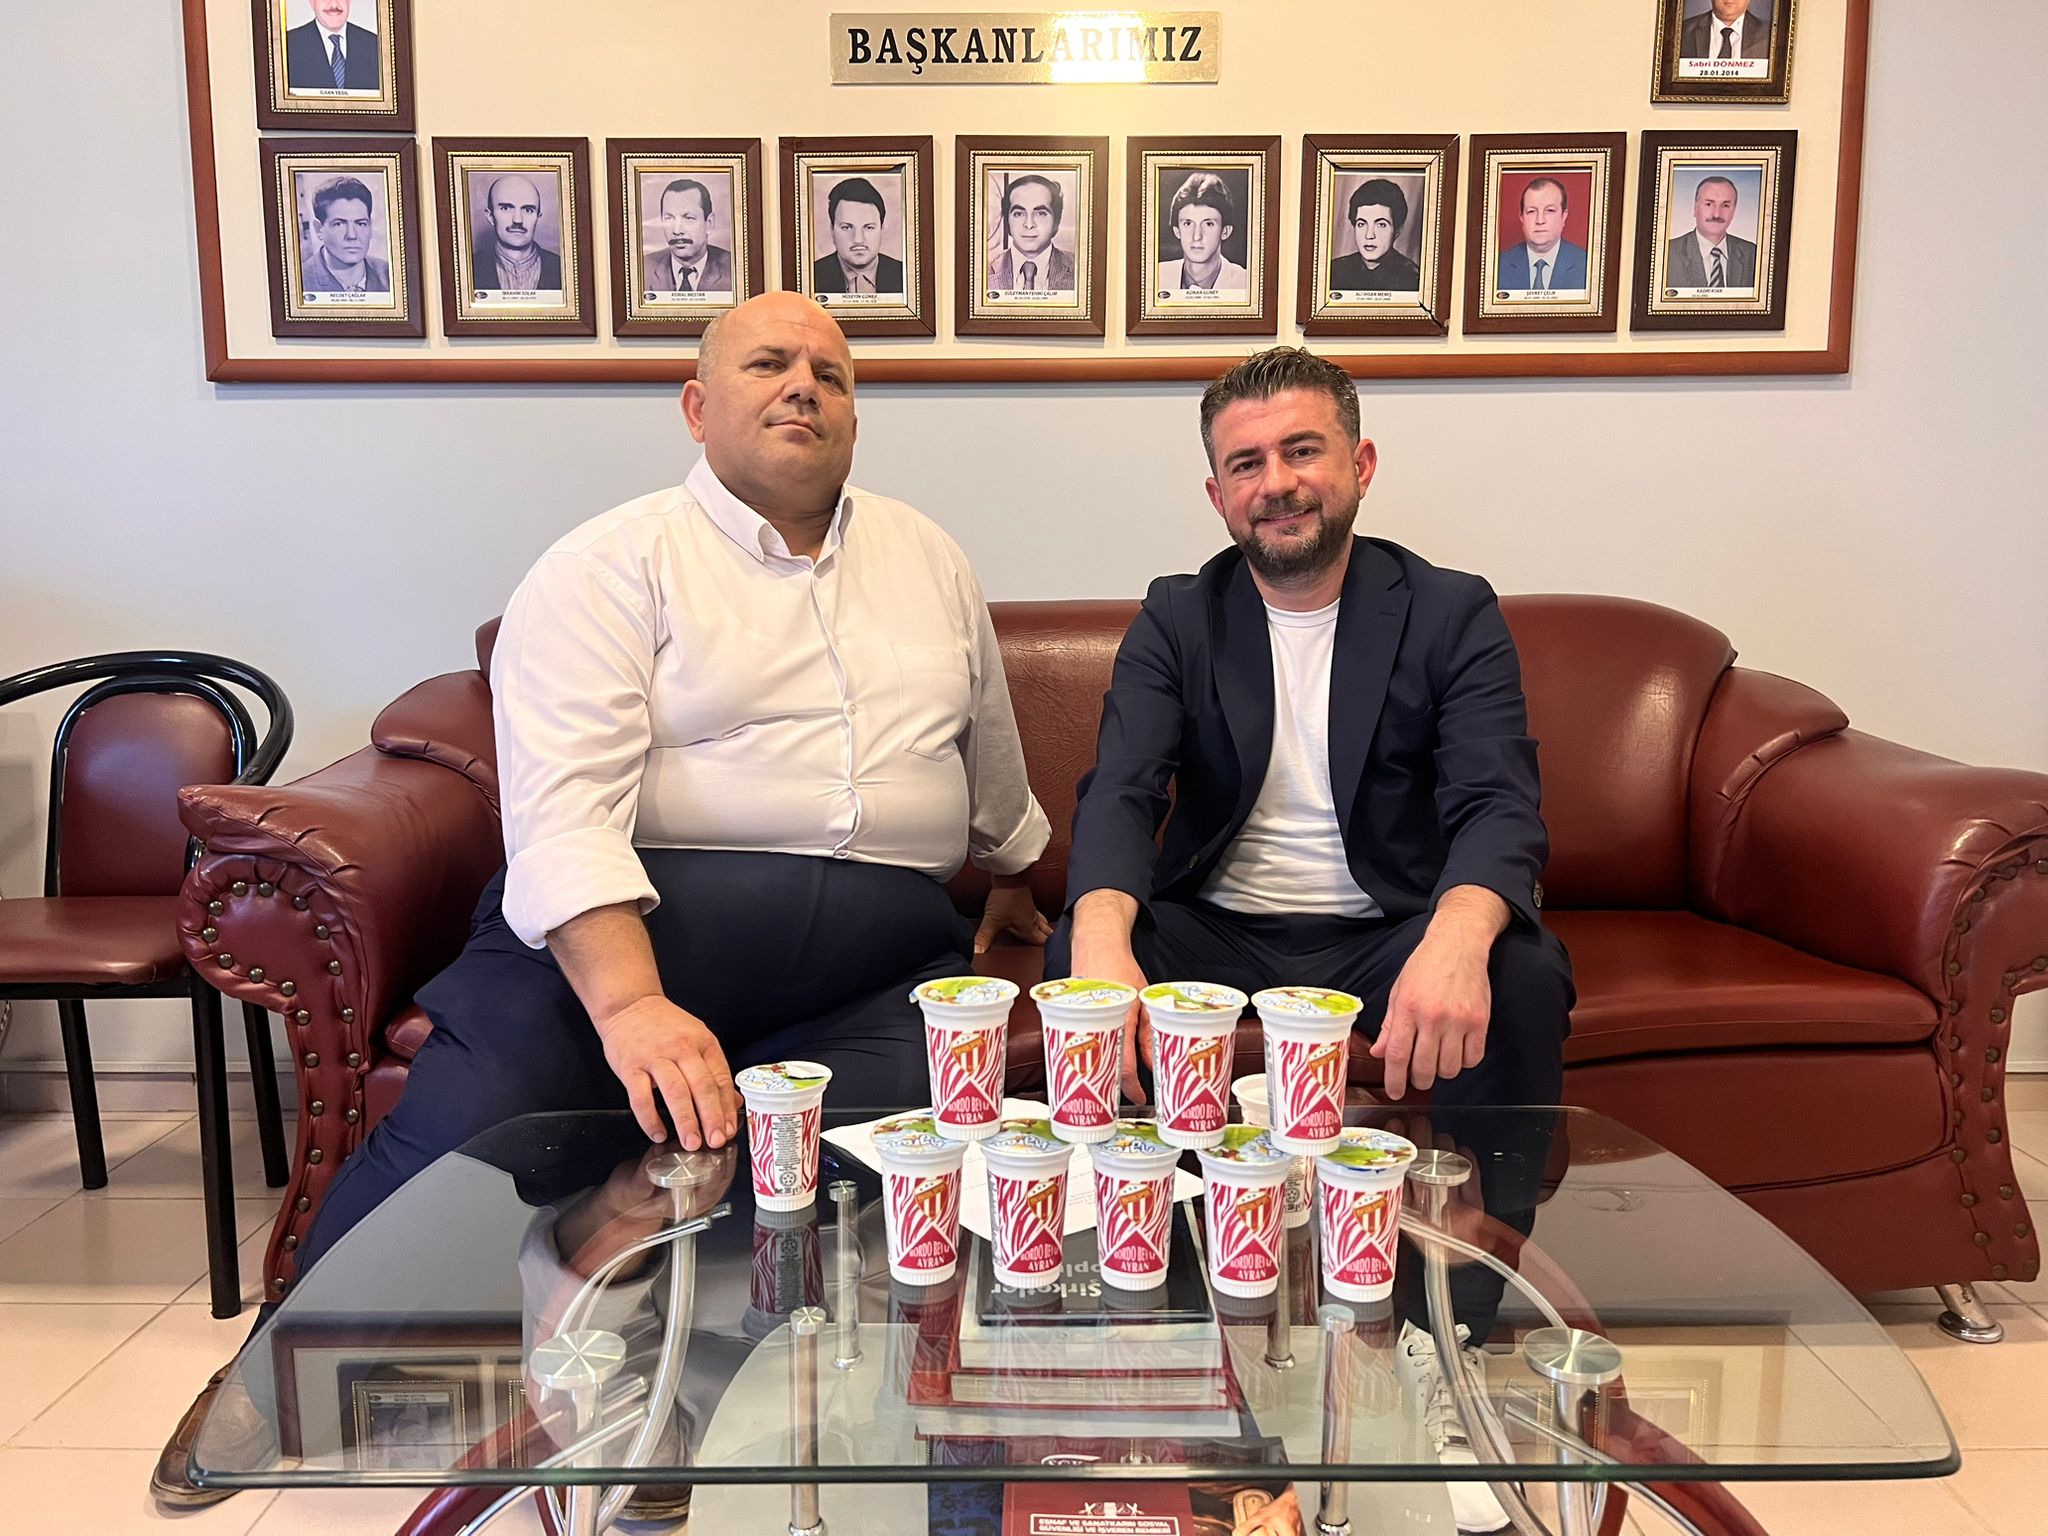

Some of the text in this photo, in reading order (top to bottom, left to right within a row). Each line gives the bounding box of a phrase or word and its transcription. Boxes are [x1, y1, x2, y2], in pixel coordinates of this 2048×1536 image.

[847, 27, 1202, 75] BAŞKANLARIMIZ
[948, 1096, 971, 1112] BORDO
[1061, 1098, 1084, 1114] BORDO
[1181, 1103, 1206, 1119] BORDO
[955, 1112, 984, 1124] AYRAN
[1068, 1114, 1097, 1126] AYRAN
[1189, 1119, 1217, 1131] AYRAN
[1299, 1110, 1324, 1127] BORDO
[1307, 1126, 1335, 1138] AYRAN
[909, 1241, 933, 1257] BORDO
[1020, 1244, 1044, 1261] BORDO
[1113, 1245, 1137, 1261] BORDO
[917, 1255, 945, 1268] AYRAN
[1028, 1258, 1054, 1272] AYRAN
[1121, 1261, 1150, 1273] AYRAN
[1229, 1253, 1254, 1269] BORDO
[1346, 1257, 1371, 1273] BORDO
[1237, 1268, 1266, 1281] AYRAN
[1354, 1273, 1382, 1284] AYRAN
[1038, 1518, 1067, 1526] ESNAF
[1081, 1519, 1136, 1527] SANATKARIN
[1038, 1525, 1084, 1533] GÜVENLİĞİ
[1097, 1526, 1133, 1534] İŞVEREN
